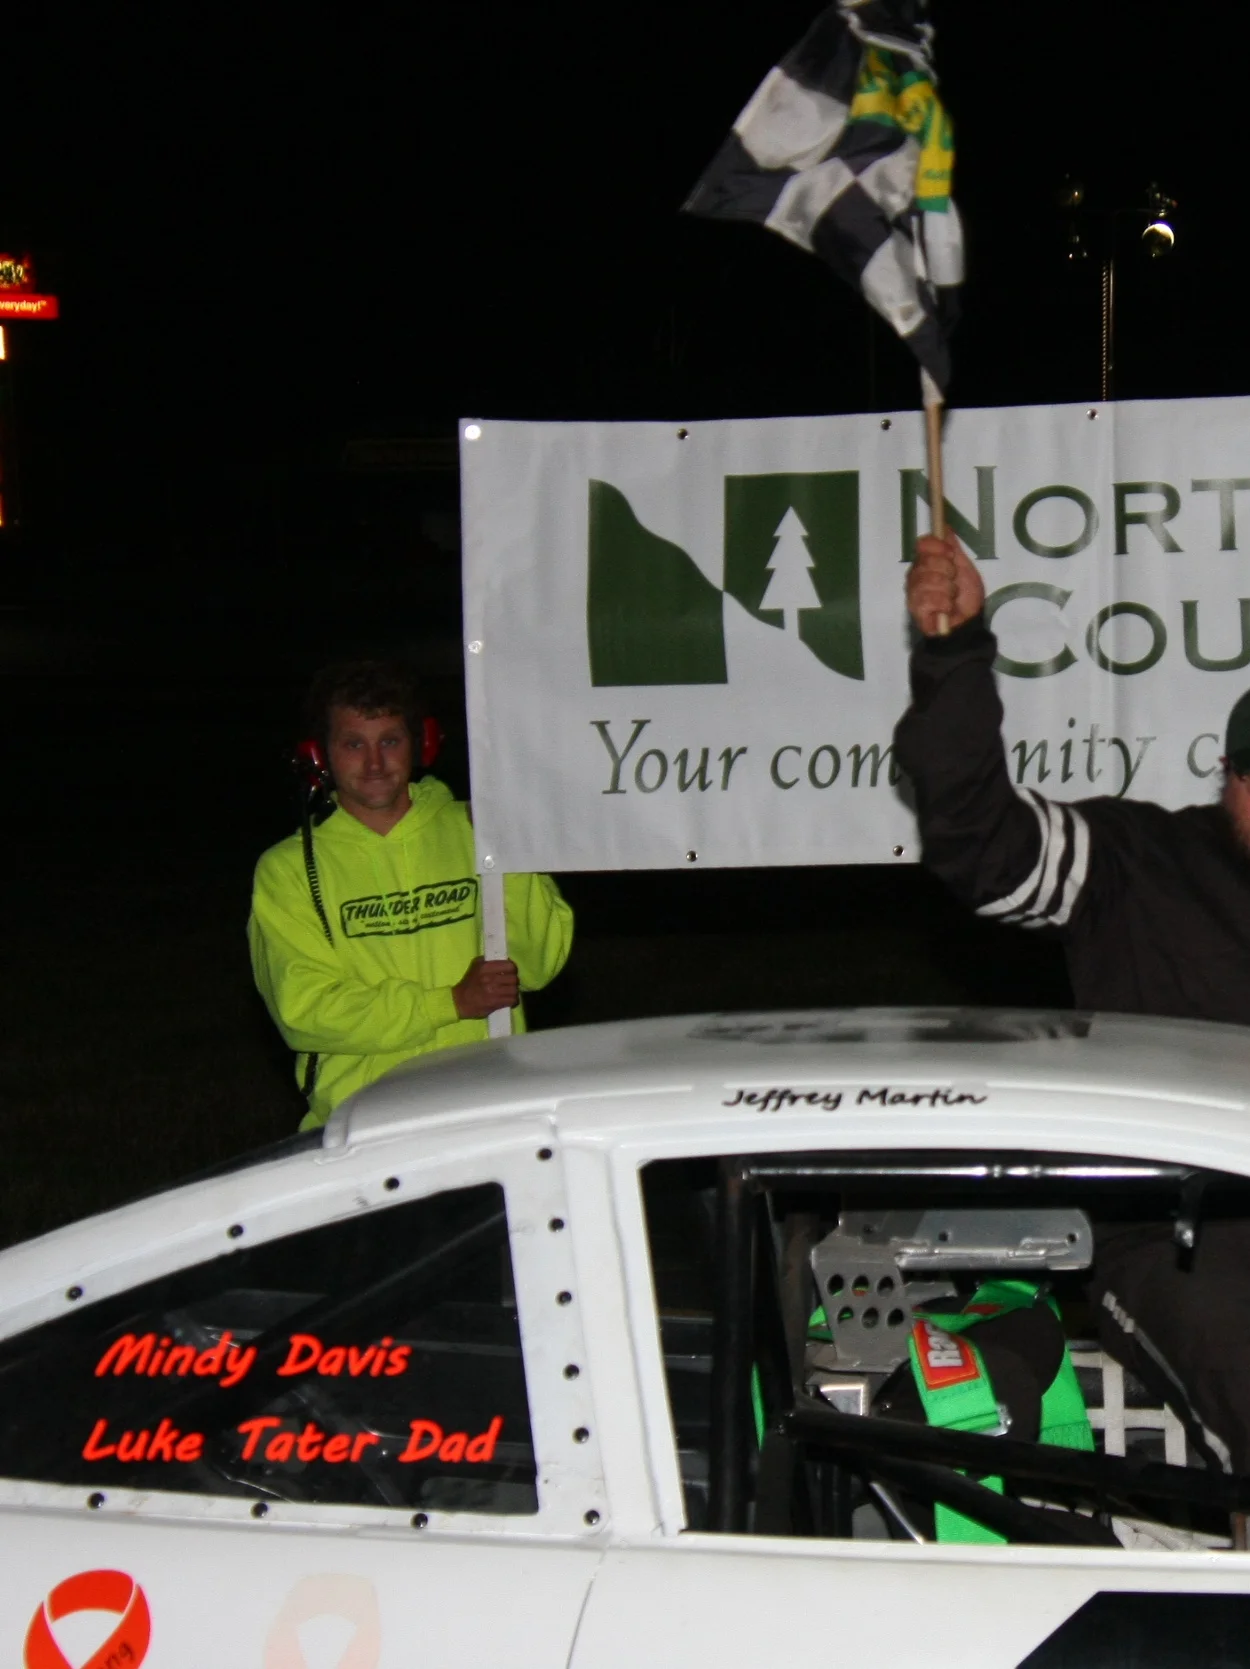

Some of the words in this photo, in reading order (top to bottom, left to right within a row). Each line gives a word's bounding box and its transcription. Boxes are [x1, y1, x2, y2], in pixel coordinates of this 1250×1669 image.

[590, 718, 747, 795] Your
[769, 716, 1156, 799] comnity
[424, 885, 471, 908] ROAD
[721, 1088, 842, 1112] Jeffrey
[855, 1088, 987, 1107] Martin
[95, 1331, 257, 1388] Mindy
[277, 1334, 412, 1377] Davis
[82, 1416, 205, 1463] Luke
[237, 1416, 379, 1463] Tater
[398, 1416, 504, 1463] Dad
